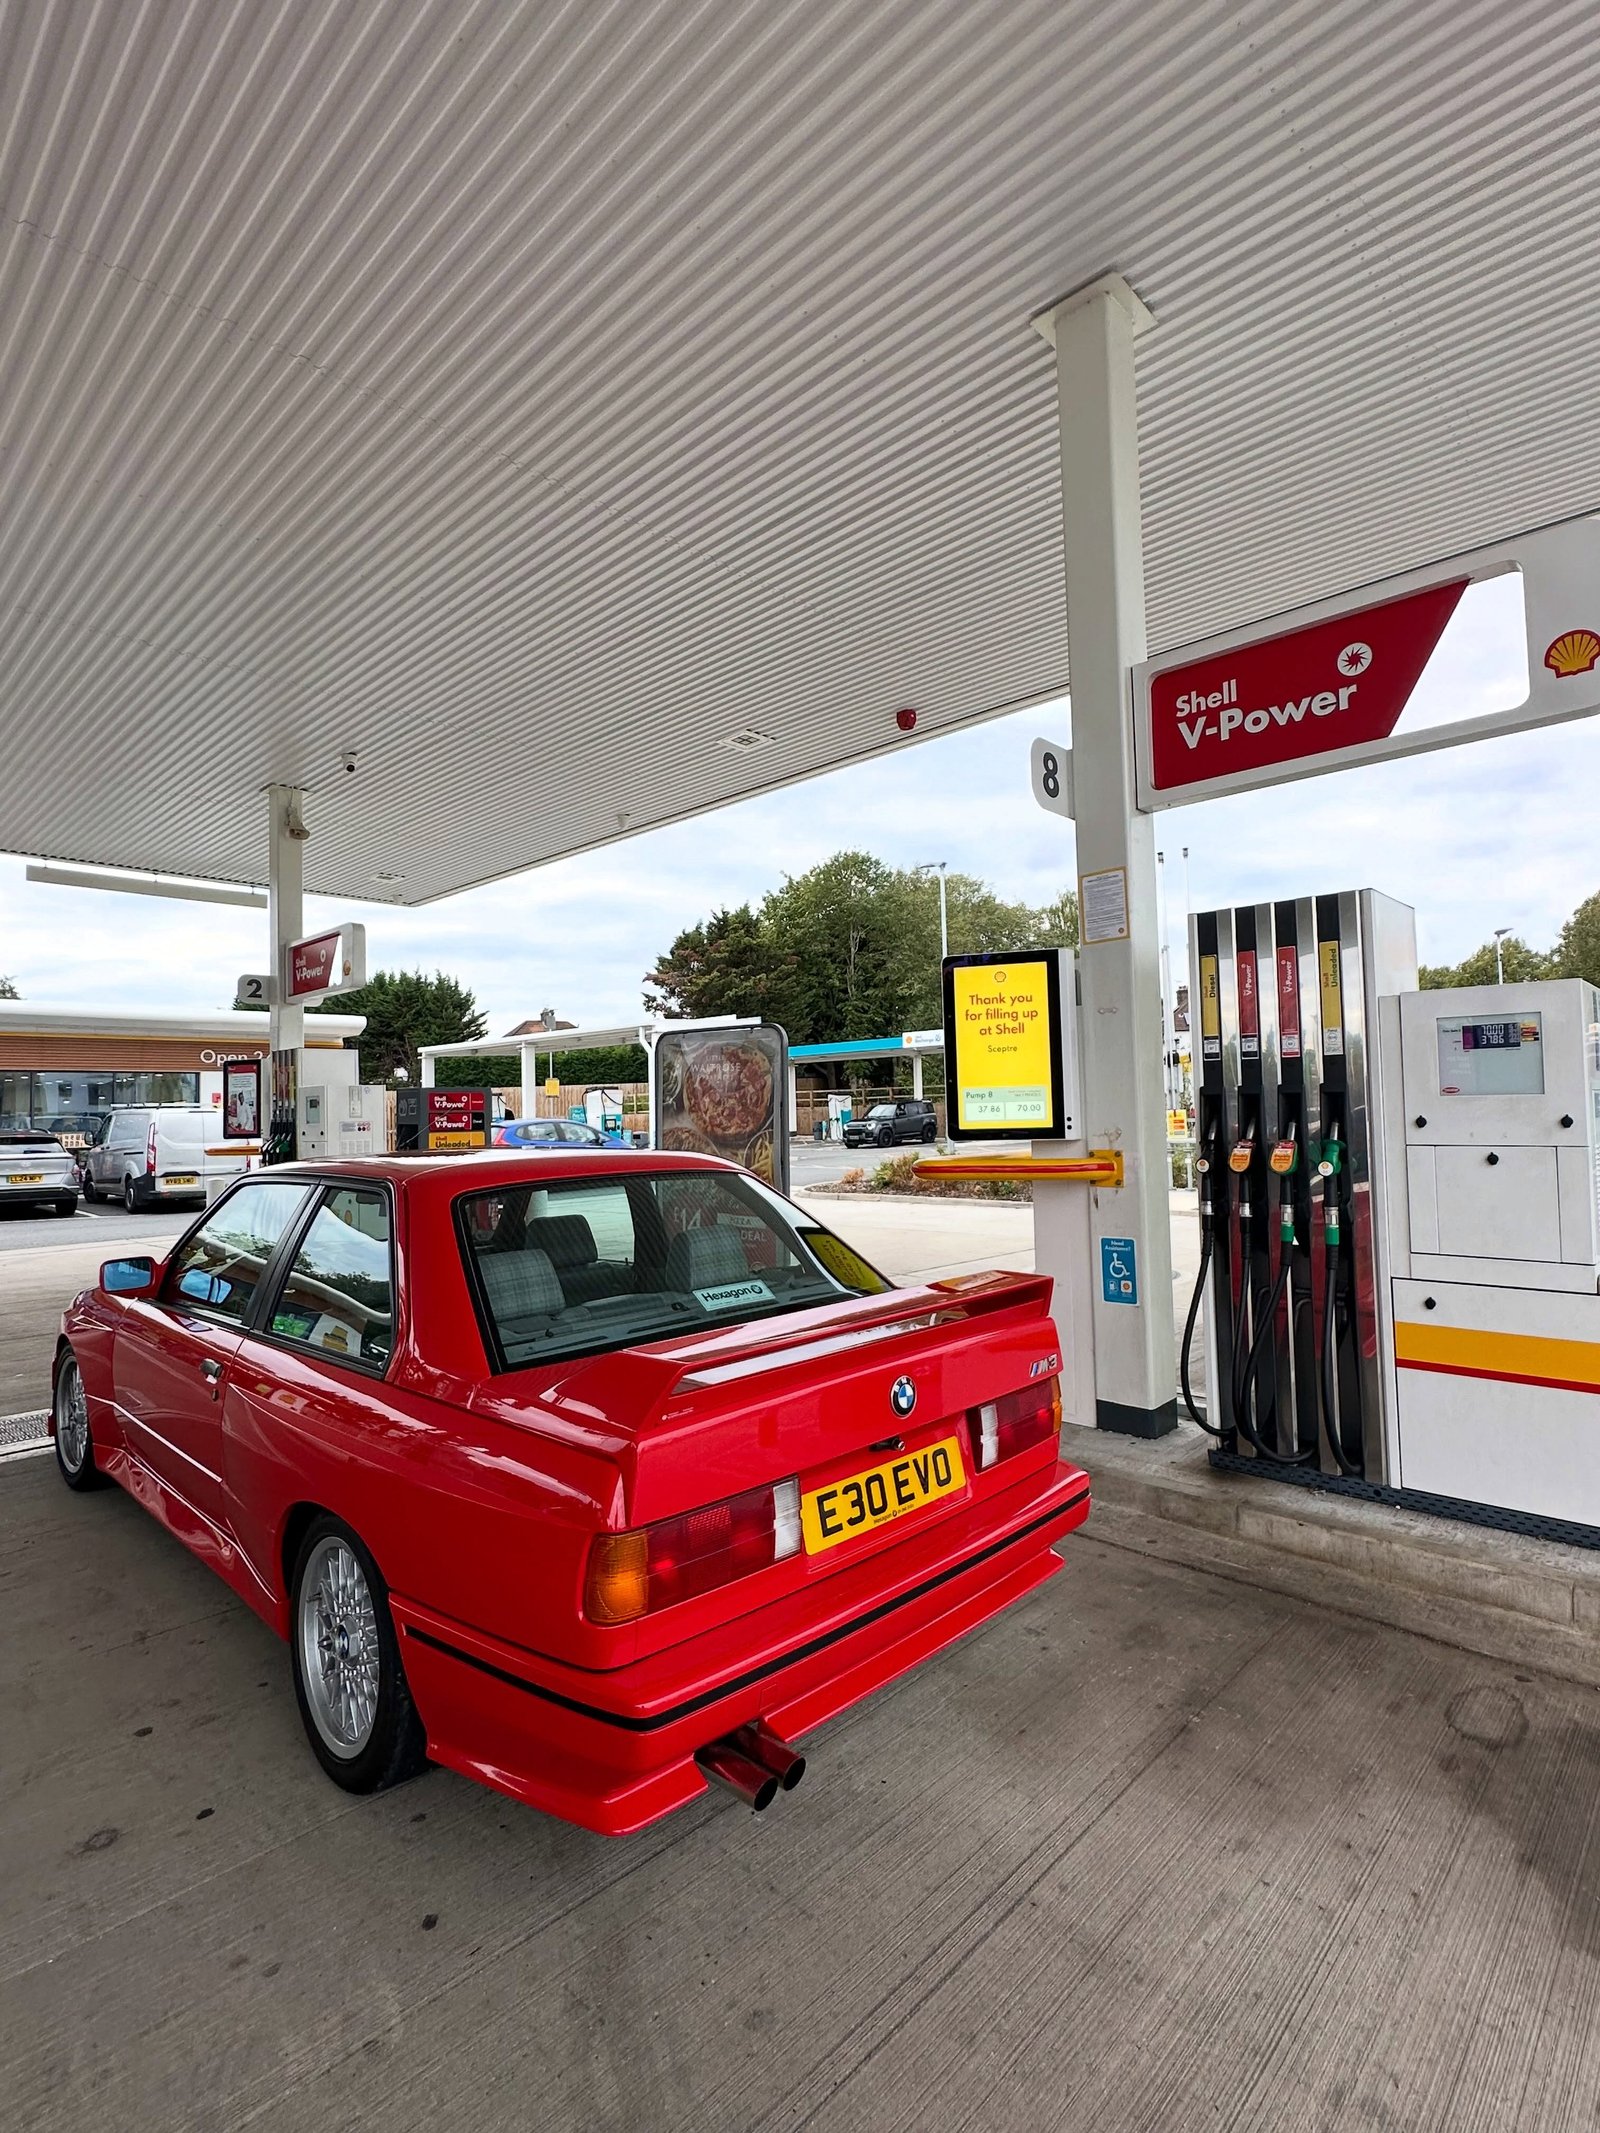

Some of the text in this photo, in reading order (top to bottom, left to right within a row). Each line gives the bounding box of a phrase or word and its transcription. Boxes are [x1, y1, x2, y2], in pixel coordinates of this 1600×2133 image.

[1176, 679, 1237, 717] Shell
[1177, 684, 1358, 750] V-Power
[1042, 751, 1060, 799] 8
[295, 964, 325, 982] V-Power
[1330, 948, 1338, 988] Unleaded
[1245, 964, 1253, 996] V-Power
[1285, 960, 1293, 993] V-Power
[246, 978, 263, 999] 2
[969, 992, 1033, 1006] Thank you
[965, 1008, 1038, 1022] for filling up
[979, 1022, 1025, 1036] at Shell
[1481, 1024, 1504, 1035] 70.00
[1481, 1033, 1504, 1045] 37.86
[988, 1044, 1018, 1054] Sceptre
[200, 1049, 248, 1067] Open
[690, 1062, 741, 1073] WAITROSE
[966, 1091, 986, 1100] Pump
[434, 1101, 466, 1109] V-Power
[978, 1104, 1042, 1113] 37.86 70.00
[435, 1140, 471, 1148] Unleaded
[740, 1230, 765, 1241] DEAL
[701, 1287, 751, 1303] Hexagon
[1031, 1354, 1058, 1377] M3
[816, 1447, 952, 1539] E30 EVO
